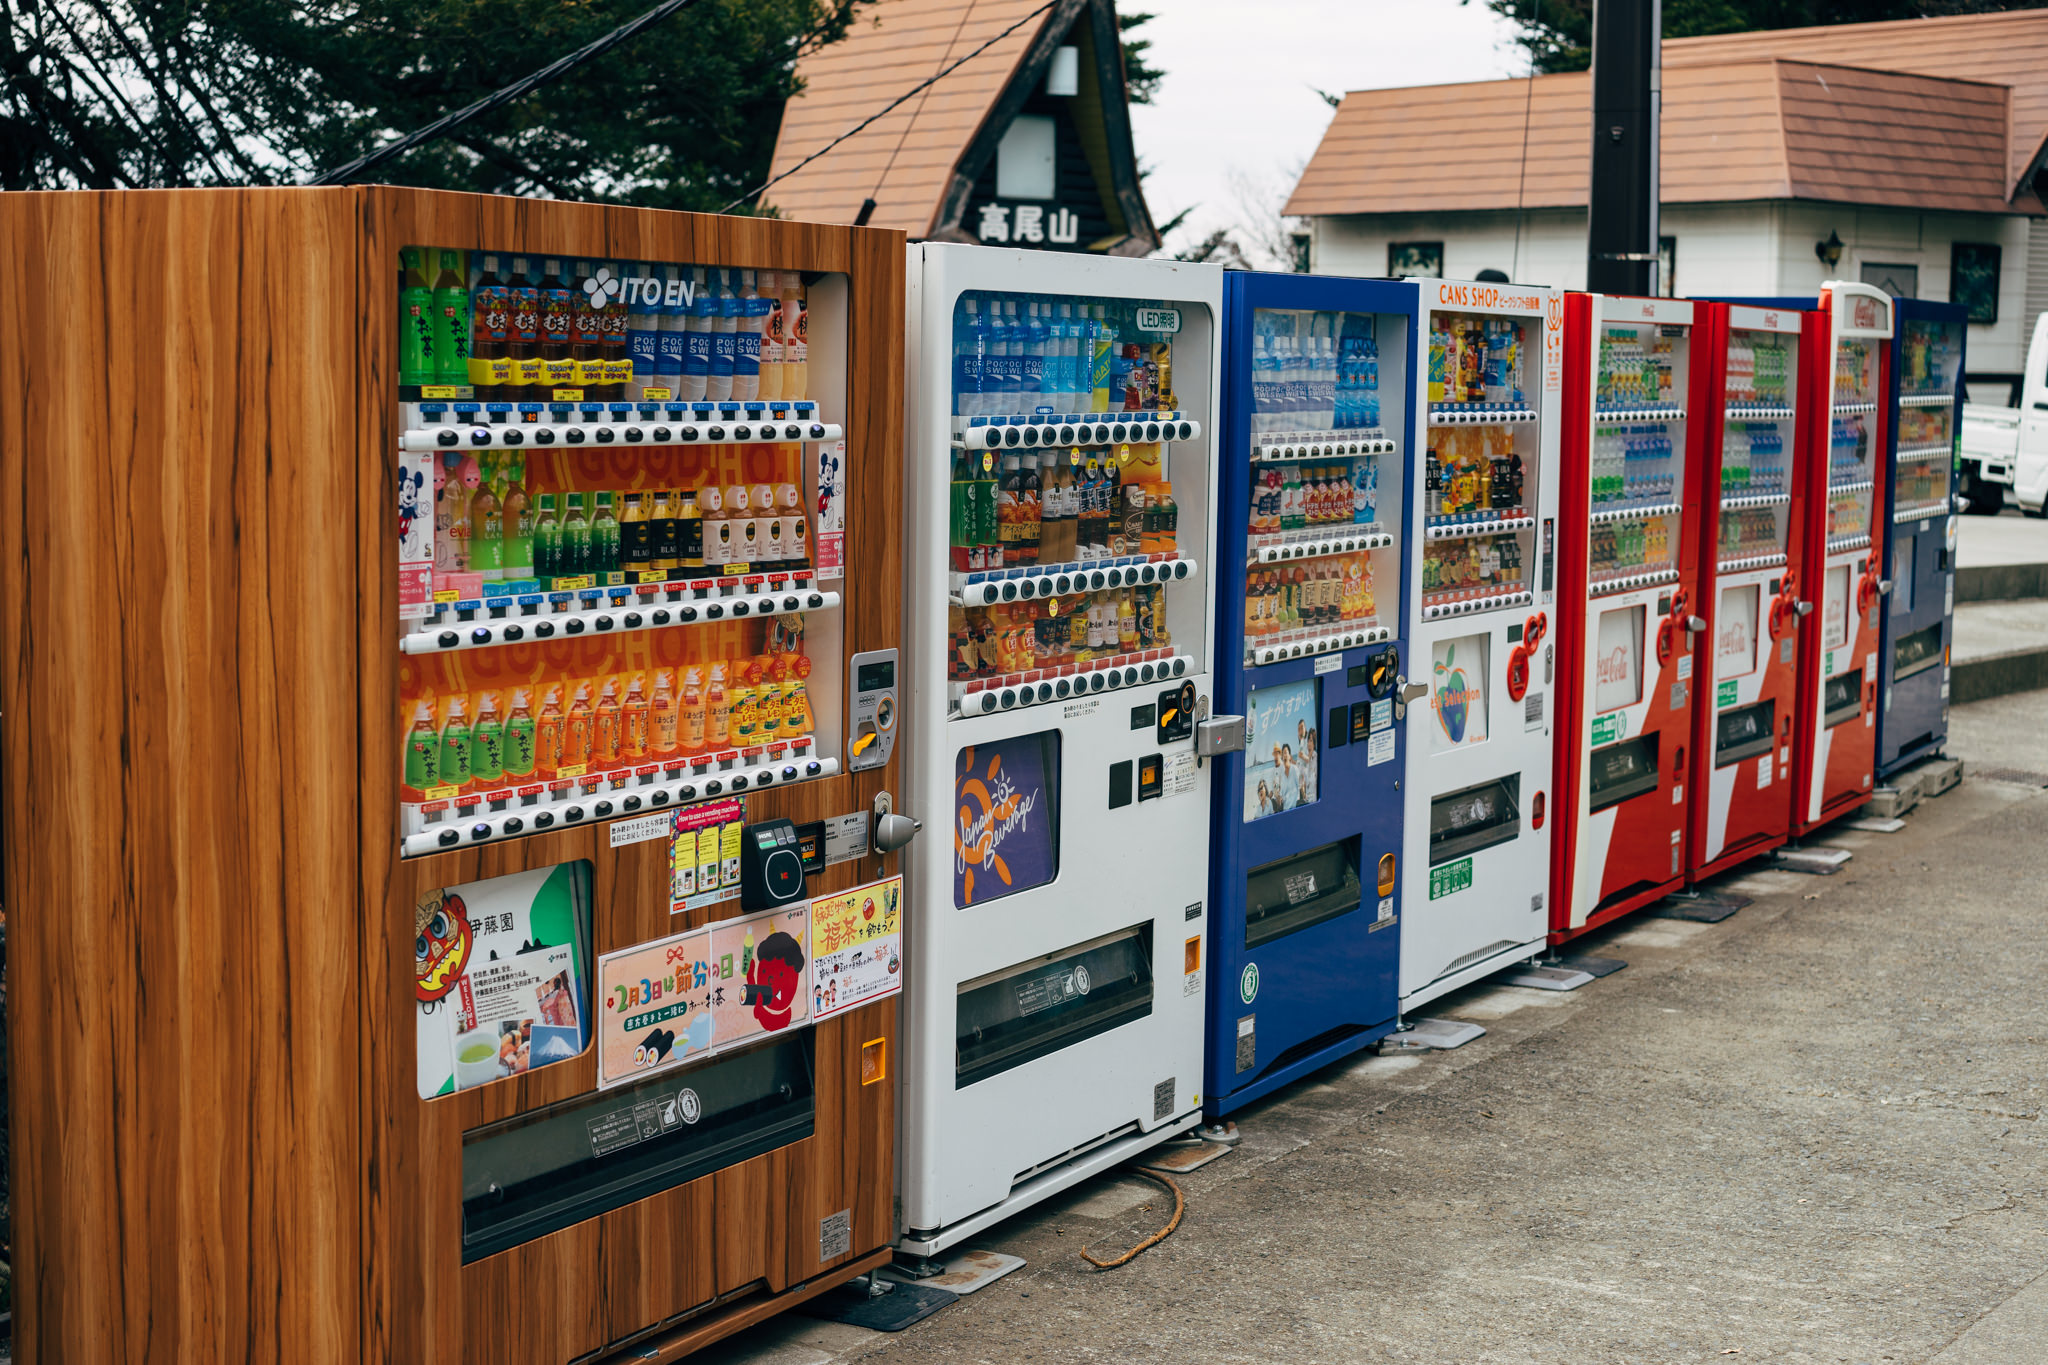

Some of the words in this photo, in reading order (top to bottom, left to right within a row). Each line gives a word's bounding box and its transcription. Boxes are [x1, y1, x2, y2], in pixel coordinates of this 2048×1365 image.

[979, 202, 1078, 243] 高尾山
[618, 277, 662, 306] ITO
[664, 279, 696, 307] EN
[1439, 284, 1468, 306] CANS
[1471, 287, 1499, 308] SHOP
[1141, 312, 1175, 329] LED照明
[1444, 688, 1480, 708] Selection
[704, 808, 720, 816] vending
[721, 805, 739, 813] machine
[958, 801, 998, 874] Japan
[977, 787, 1039, 872] Beverage
[468, 912, 514, 938] 伊藤園
[460, 978, 474, 1026] WELCOME
